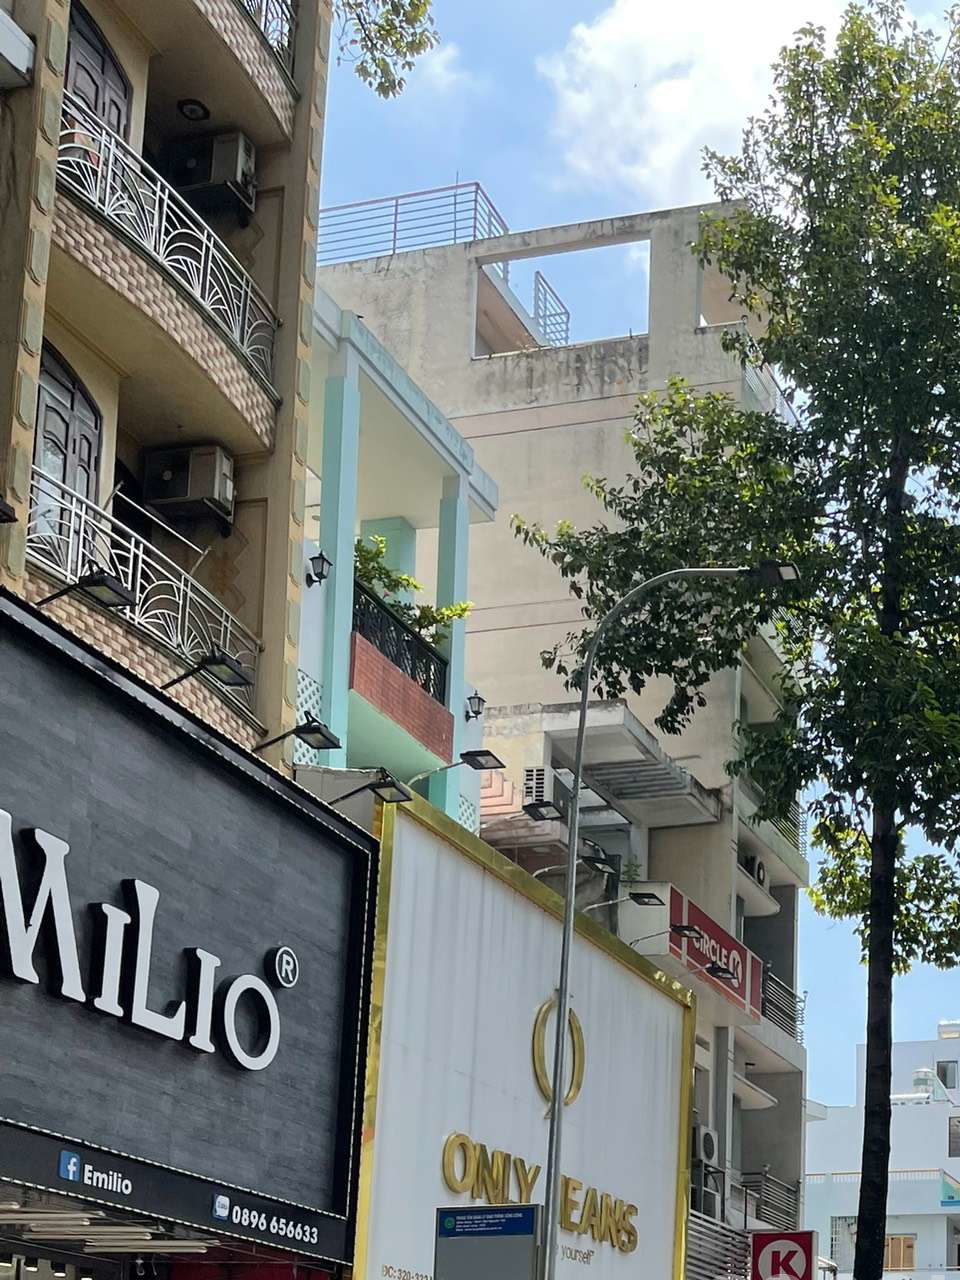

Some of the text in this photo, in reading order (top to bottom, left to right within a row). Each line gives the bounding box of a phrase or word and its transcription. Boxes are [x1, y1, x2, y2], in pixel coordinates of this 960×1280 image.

[84, 1164, 132, 1195] Emilio
[232, 1205, 318, 1244] 0896 656633
